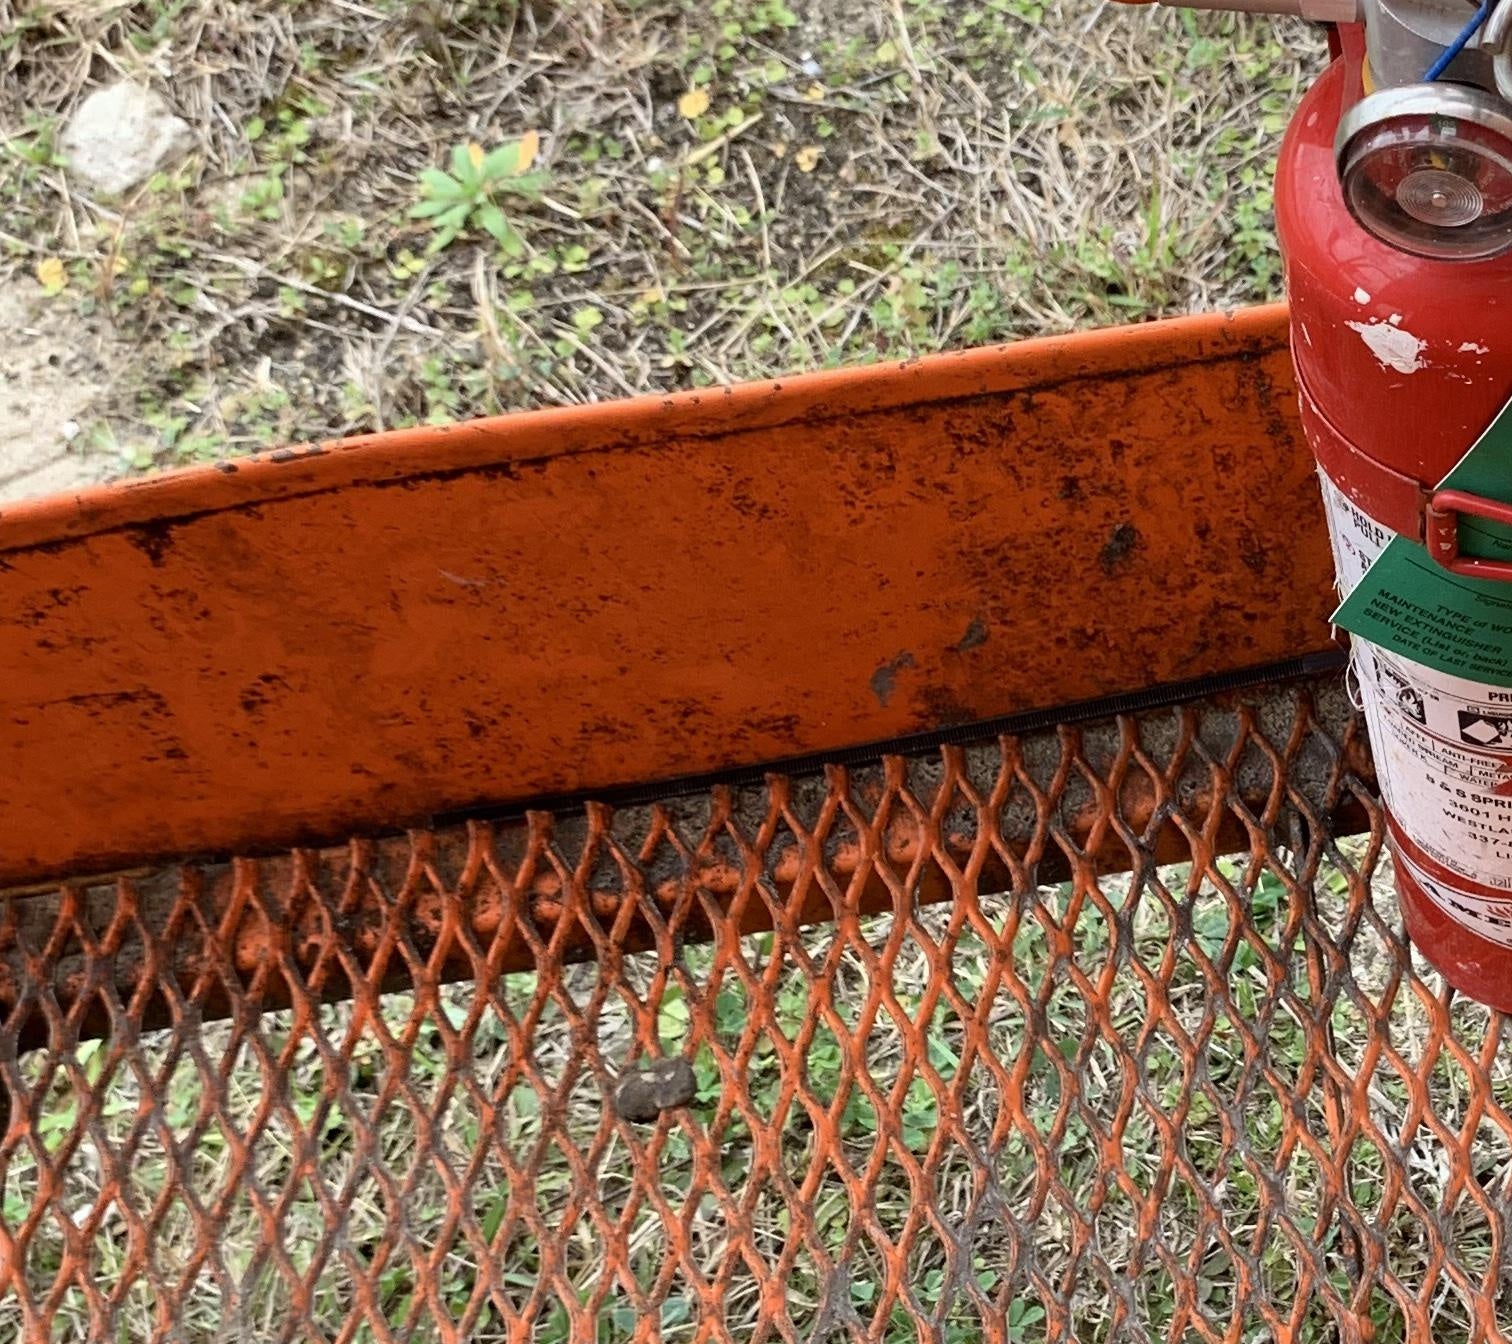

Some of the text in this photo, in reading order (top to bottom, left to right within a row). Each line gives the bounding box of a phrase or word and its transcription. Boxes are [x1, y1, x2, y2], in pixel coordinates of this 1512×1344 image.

[1351, 506, 1384, 540] HOLD
[1370, 598, 1503, 654] NEW EXTINGUISHER
[1378, 589, 1476, 636] MAINTENANCE
[1436, 604, 1472, 624] TYPE
[1473, 618, 1488, 628] of
[1363, 607, 1422, 640] SERVICE
[1472, 652, 1509, 667] back)
[1392, 633, 1419, 652] DATE
[1422, 648, 1439, 658] OF
[1439, 654, 1467, 668] LAST
[1439, 781, 1451, 792] &
[1456, 789, 1466, 798] S
[1448, 799, 1490, 819] 3601
